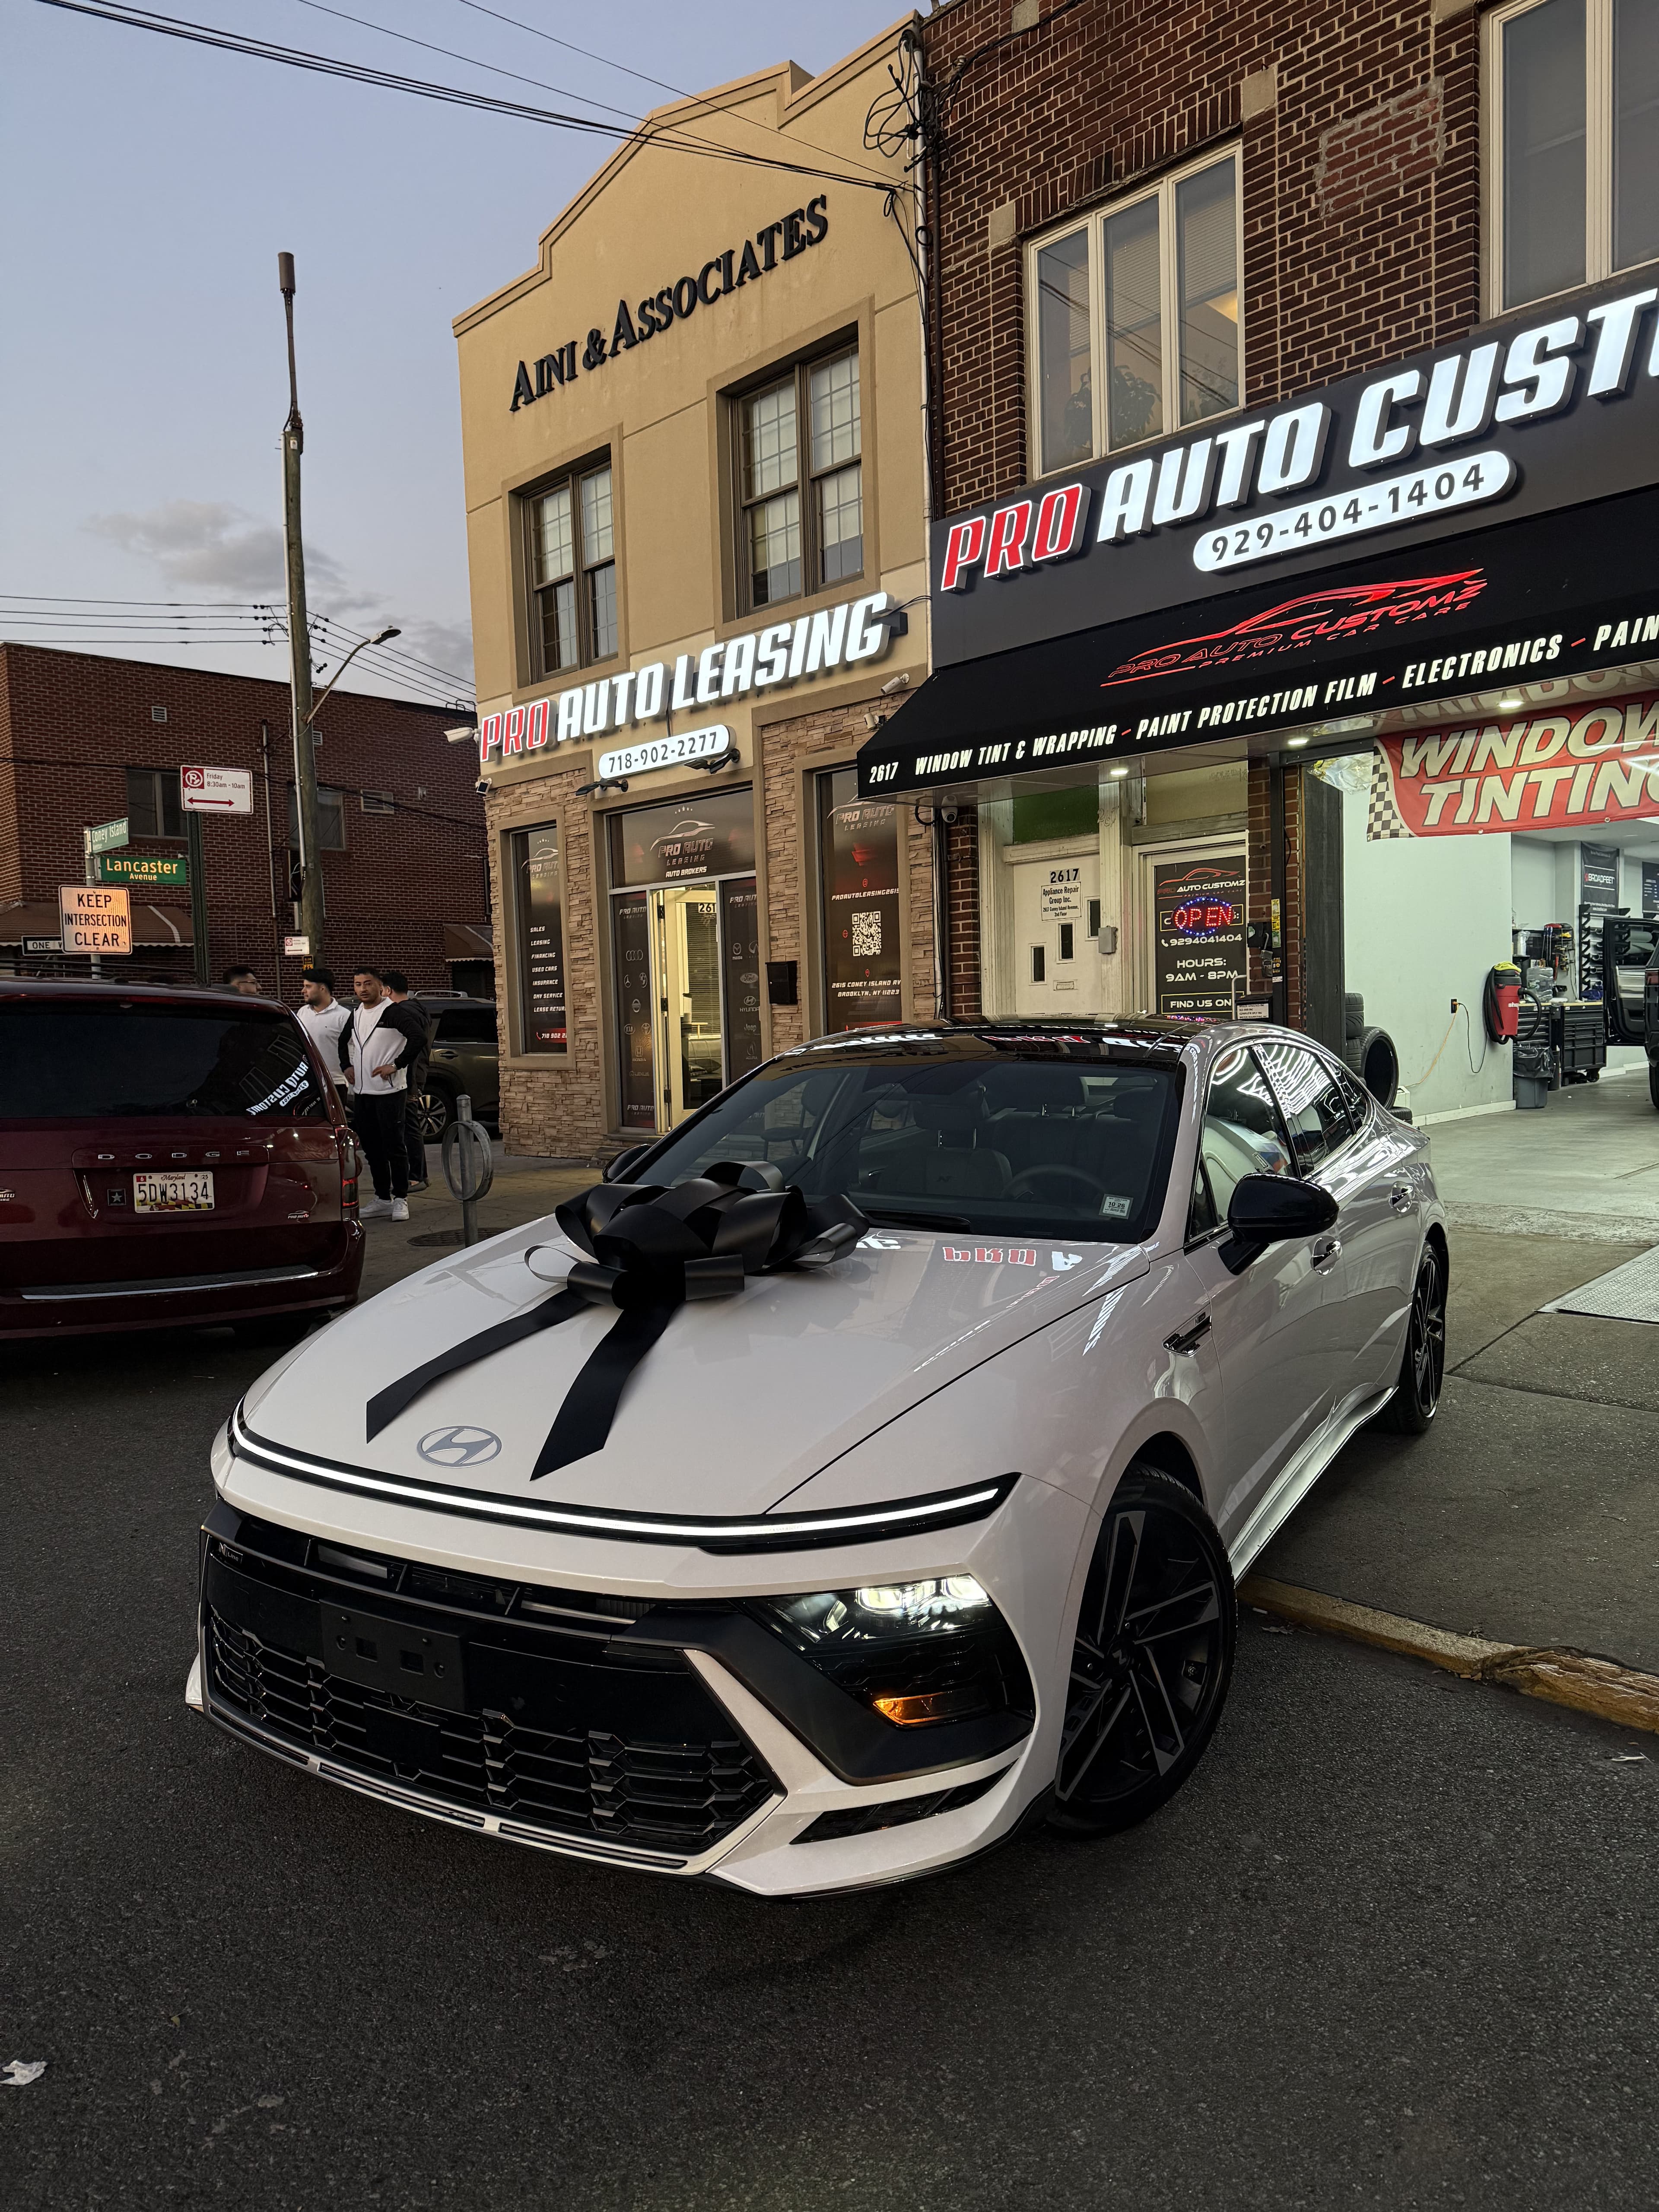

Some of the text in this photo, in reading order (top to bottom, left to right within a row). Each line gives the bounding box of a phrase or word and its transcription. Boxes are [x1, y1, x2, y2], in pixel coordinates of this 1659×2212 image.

[509, 194, 828, 412] AINI & ASSOCIATES
[941, 287, 1659, 592] PRO AUTO CUST
[1212, 464, 1484, 562] 929-404-1404
[1108, 581, 1487, 678] PRO AUTO CUSTOMZ
[1198, 602, 1471, 668] PREMIUM CAR CARE
[480, 592, 890, 763] PRO AUTO LEASING
[869, 762, 899, 783] 2617
[915, 749, 973, 775] WINDOW
[978, 742, 1011, 766] TINT
[1015, 741, 1026, 760] &
[1033, 725, 1118, 757] WRAPPING
[1136, 710, 1192, 740] PAINT
[1197, 685, 1318, 729] PROTECTION
[1324, 672, 1377, 704] FILM
[1402, 634, 1563, 689] ELECTRONICS
[609, 731, 718, 774] 718-902-2277
[835, 804, 896, 825] PRO AUTO
[92, 820, 126, 842] Coney Island
[844, 819, 886, 831] LEASING
[658, 838, 714, 858] PRO AUTO
[106, 858, 178, 874] Lancaster
[667, 855, 705, 866] LEASING
[526, 863, 542, 874] PRO
[665, 866, 707, 878] AUTO BROKERS
[1050, 868, 1079, 884] 2617
[1043, 885, 1079, 897] Appliance Repair
[1202, 880, 1246, 890] CUSTOMZ
[77, 893, 111, 908] KEEP
[699, 903, 715, 912] 261
[64, 913, 126, 927] INTERSECTION
[1175, 906, 1232, 929] OPEN
[75, 932, 119, 946] CLEAR
[1170, 934, 1243, 946] 9294041404
[1177, 957, 1227, 969] HOURS:
[1166, 973, 1197, 982] 9AM
[1208, 970, 1238, 980] 8PM
[1170, 1000, 1194, 1008] FIND
[744, 1023, 756, 1032] Jeep
[98, 1150, 249, 1159] DODGE
[161, 1173, 186, 1182] Maryland
[138, 1182, 209, 1203] 5DW3134
[228, 1551, 239, 1561] Line
